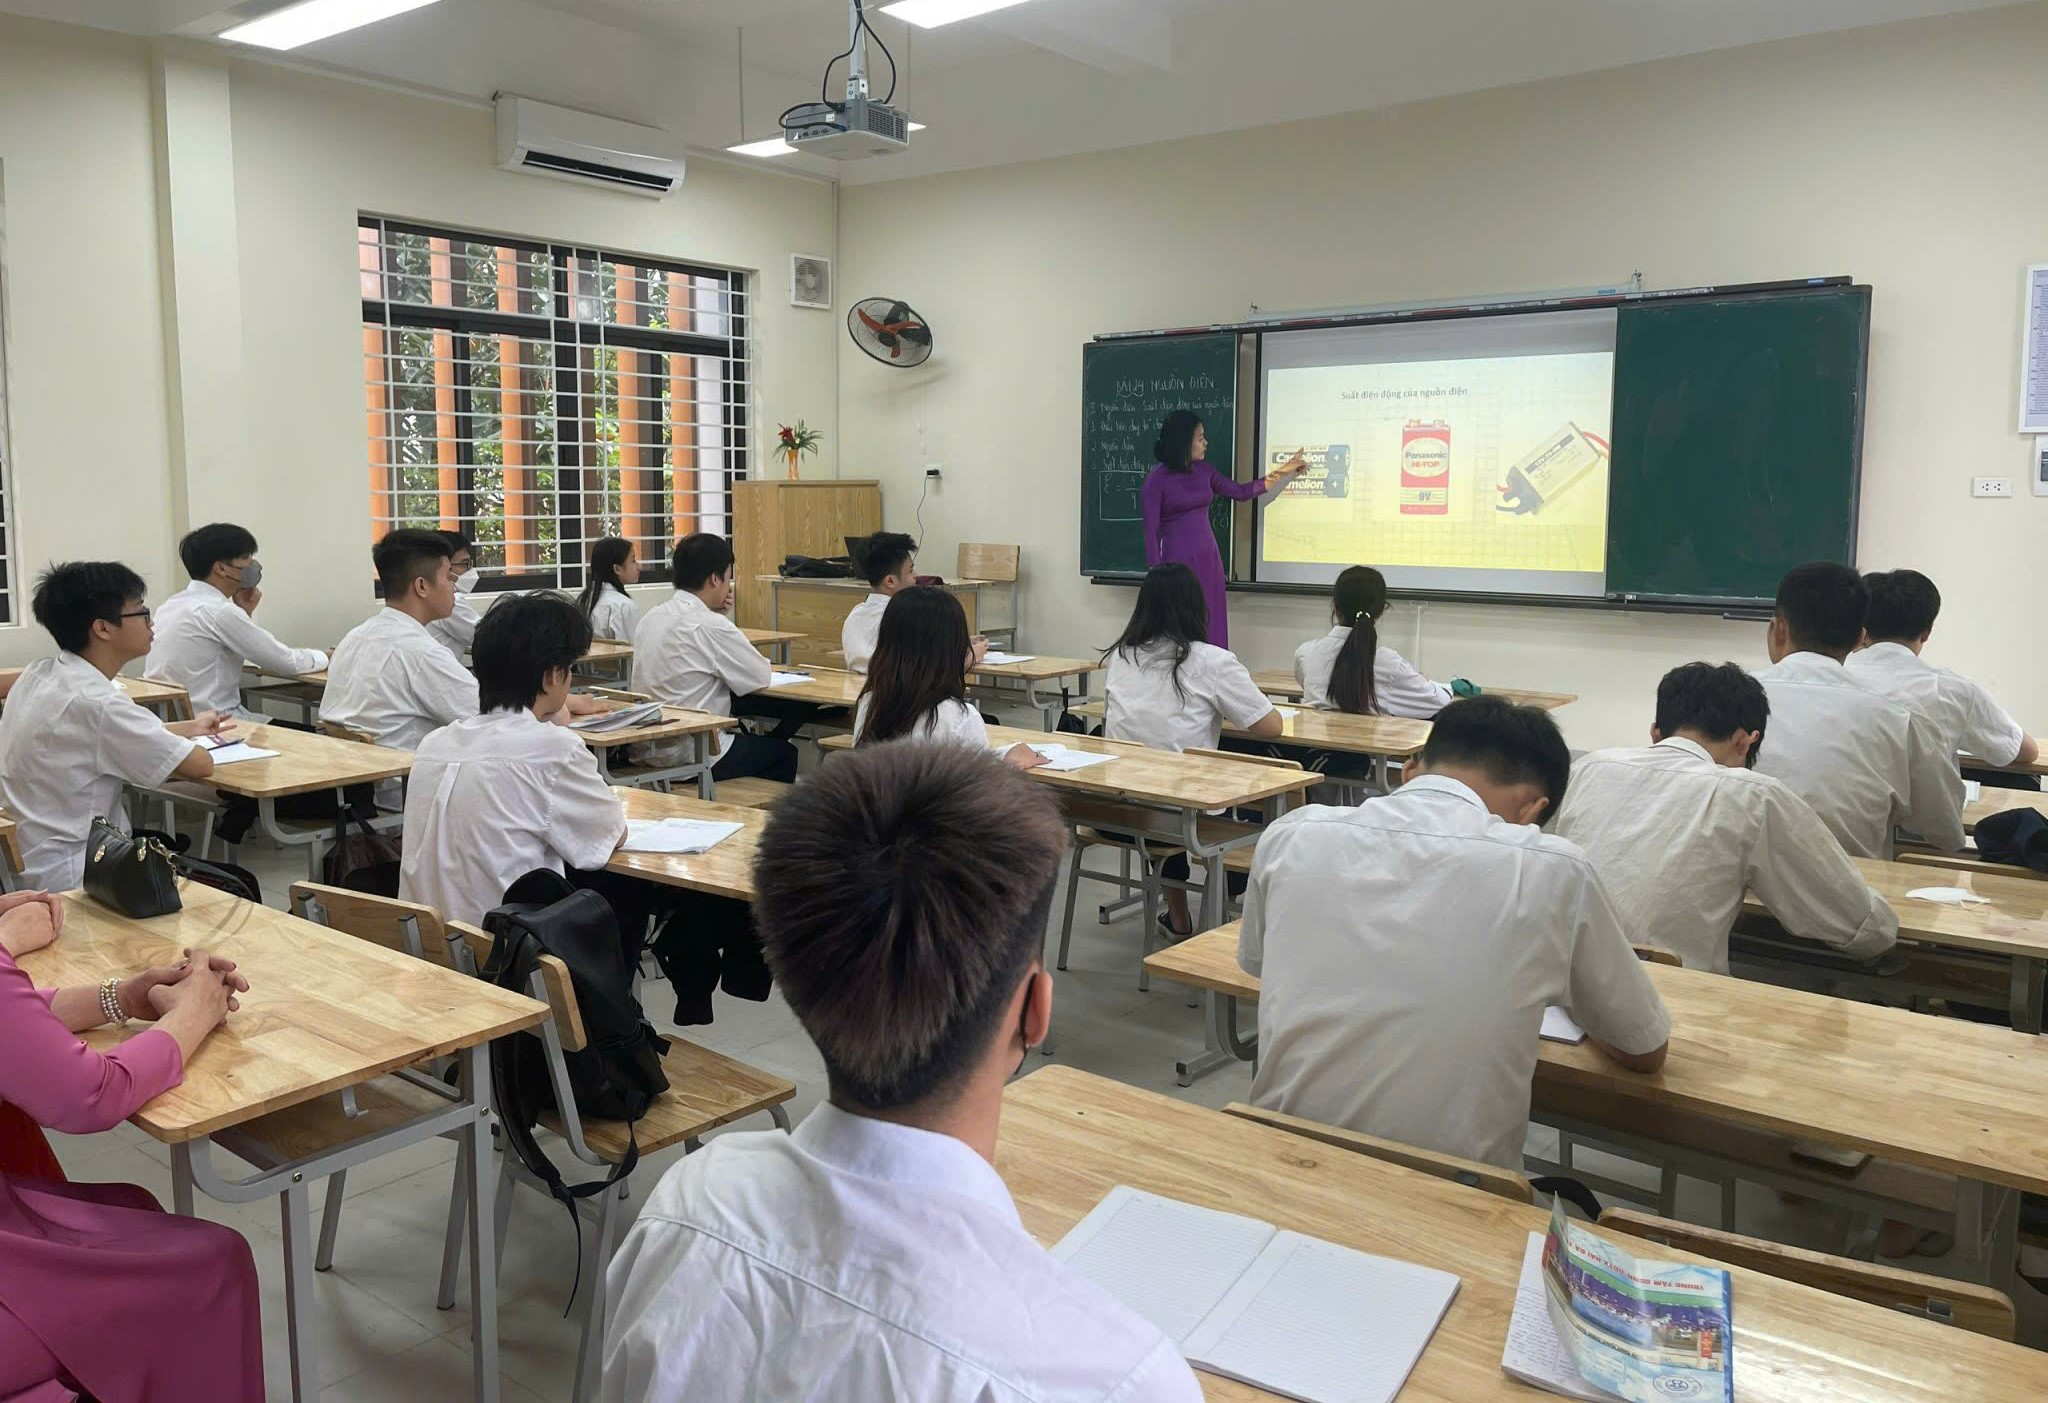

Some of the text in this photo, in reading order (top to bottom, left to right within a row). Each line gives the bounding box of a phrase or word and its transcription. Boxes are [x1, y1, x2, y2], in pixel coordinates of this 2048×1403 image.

[1341, 386, 1468, 401] Suất điện động của nguồn điện
[1276, 452, 1326, 463] Caelion
[1405, 451, 1447, 459] Panasonic
[1419, 492, 1431, 501] 9V
